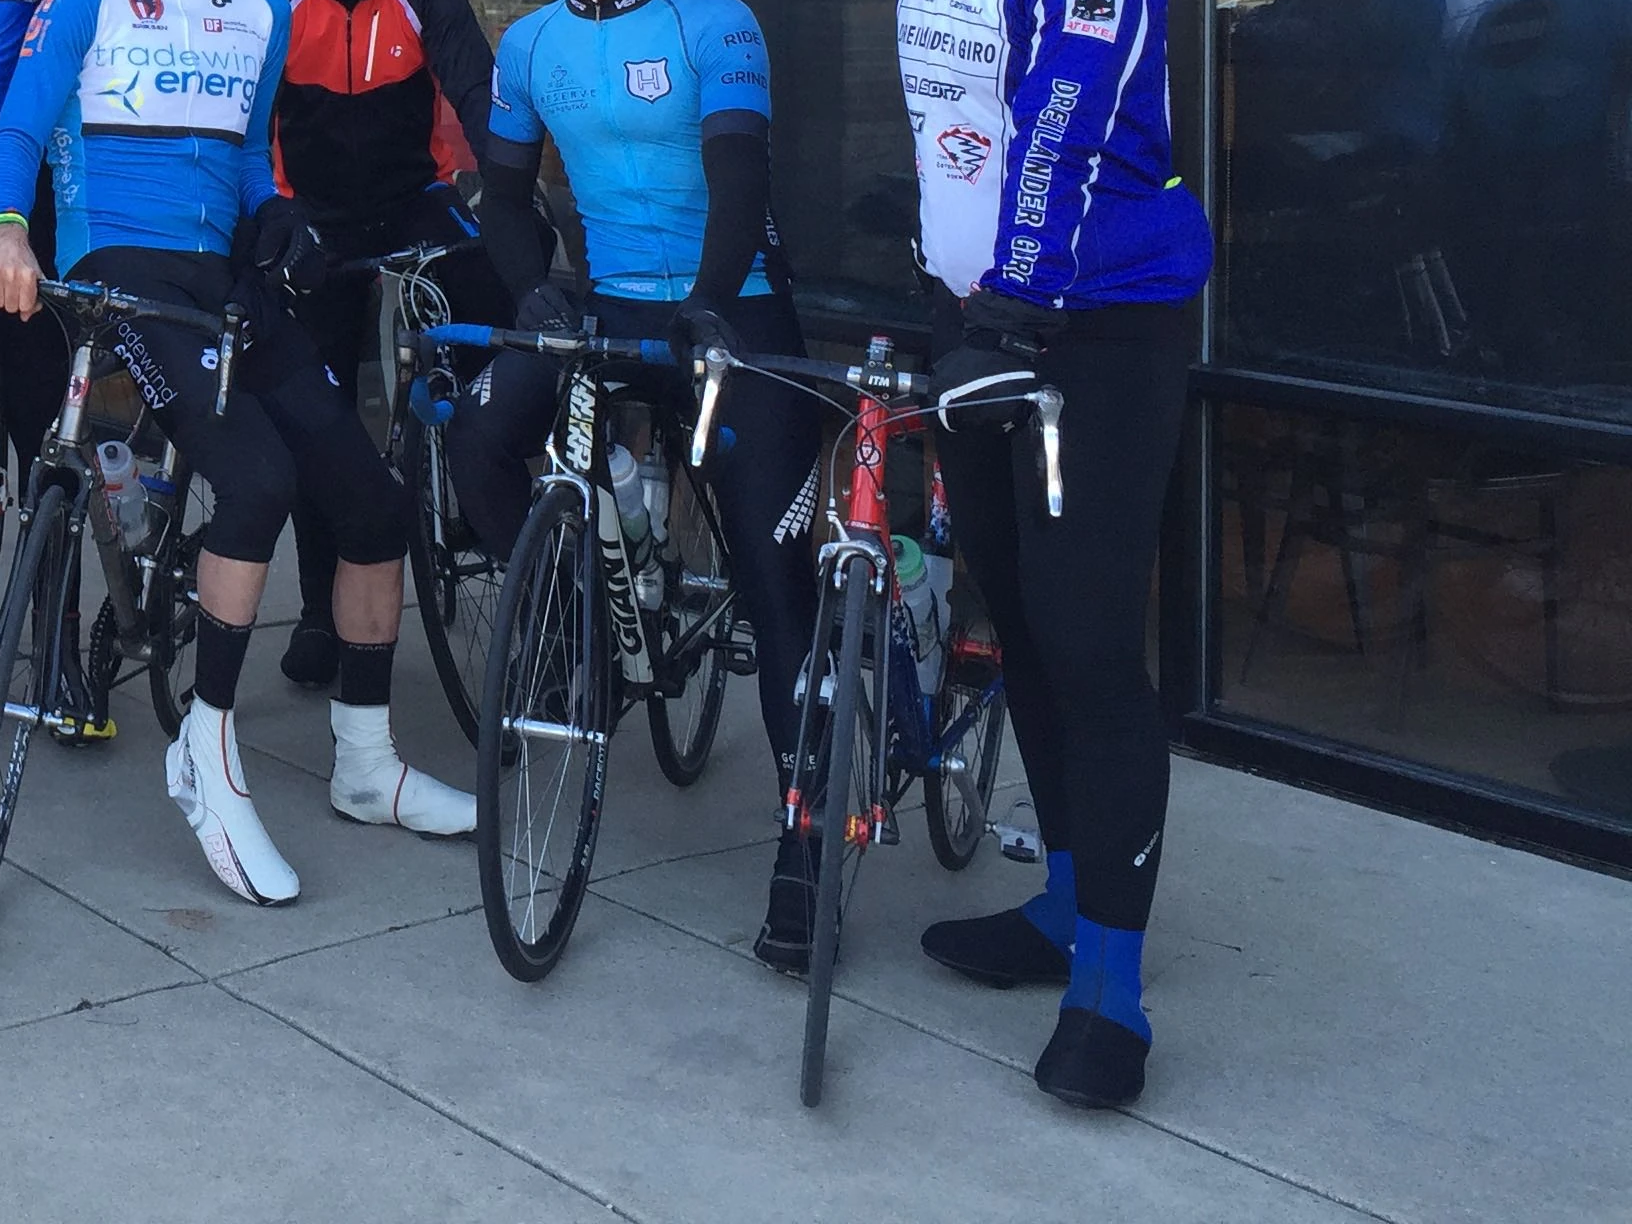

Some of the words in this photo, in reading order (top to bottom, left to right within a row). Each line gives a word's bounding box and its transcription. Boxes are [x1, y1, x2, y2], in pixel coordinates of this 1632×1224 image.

[723, 30, 762, 48] RIDE
[958, 38, 997, 65] GIRO
[155, 70, 257, 114] energ
[636, 67, 661, 92] H
[721, 71, 768, 90] GRIND
[109, 312, 179, 404] adewind
[868, 374, 891, 388] ITM
[781, 752, 816, 765] GOE
[204, 831, 241, 890] PRO
